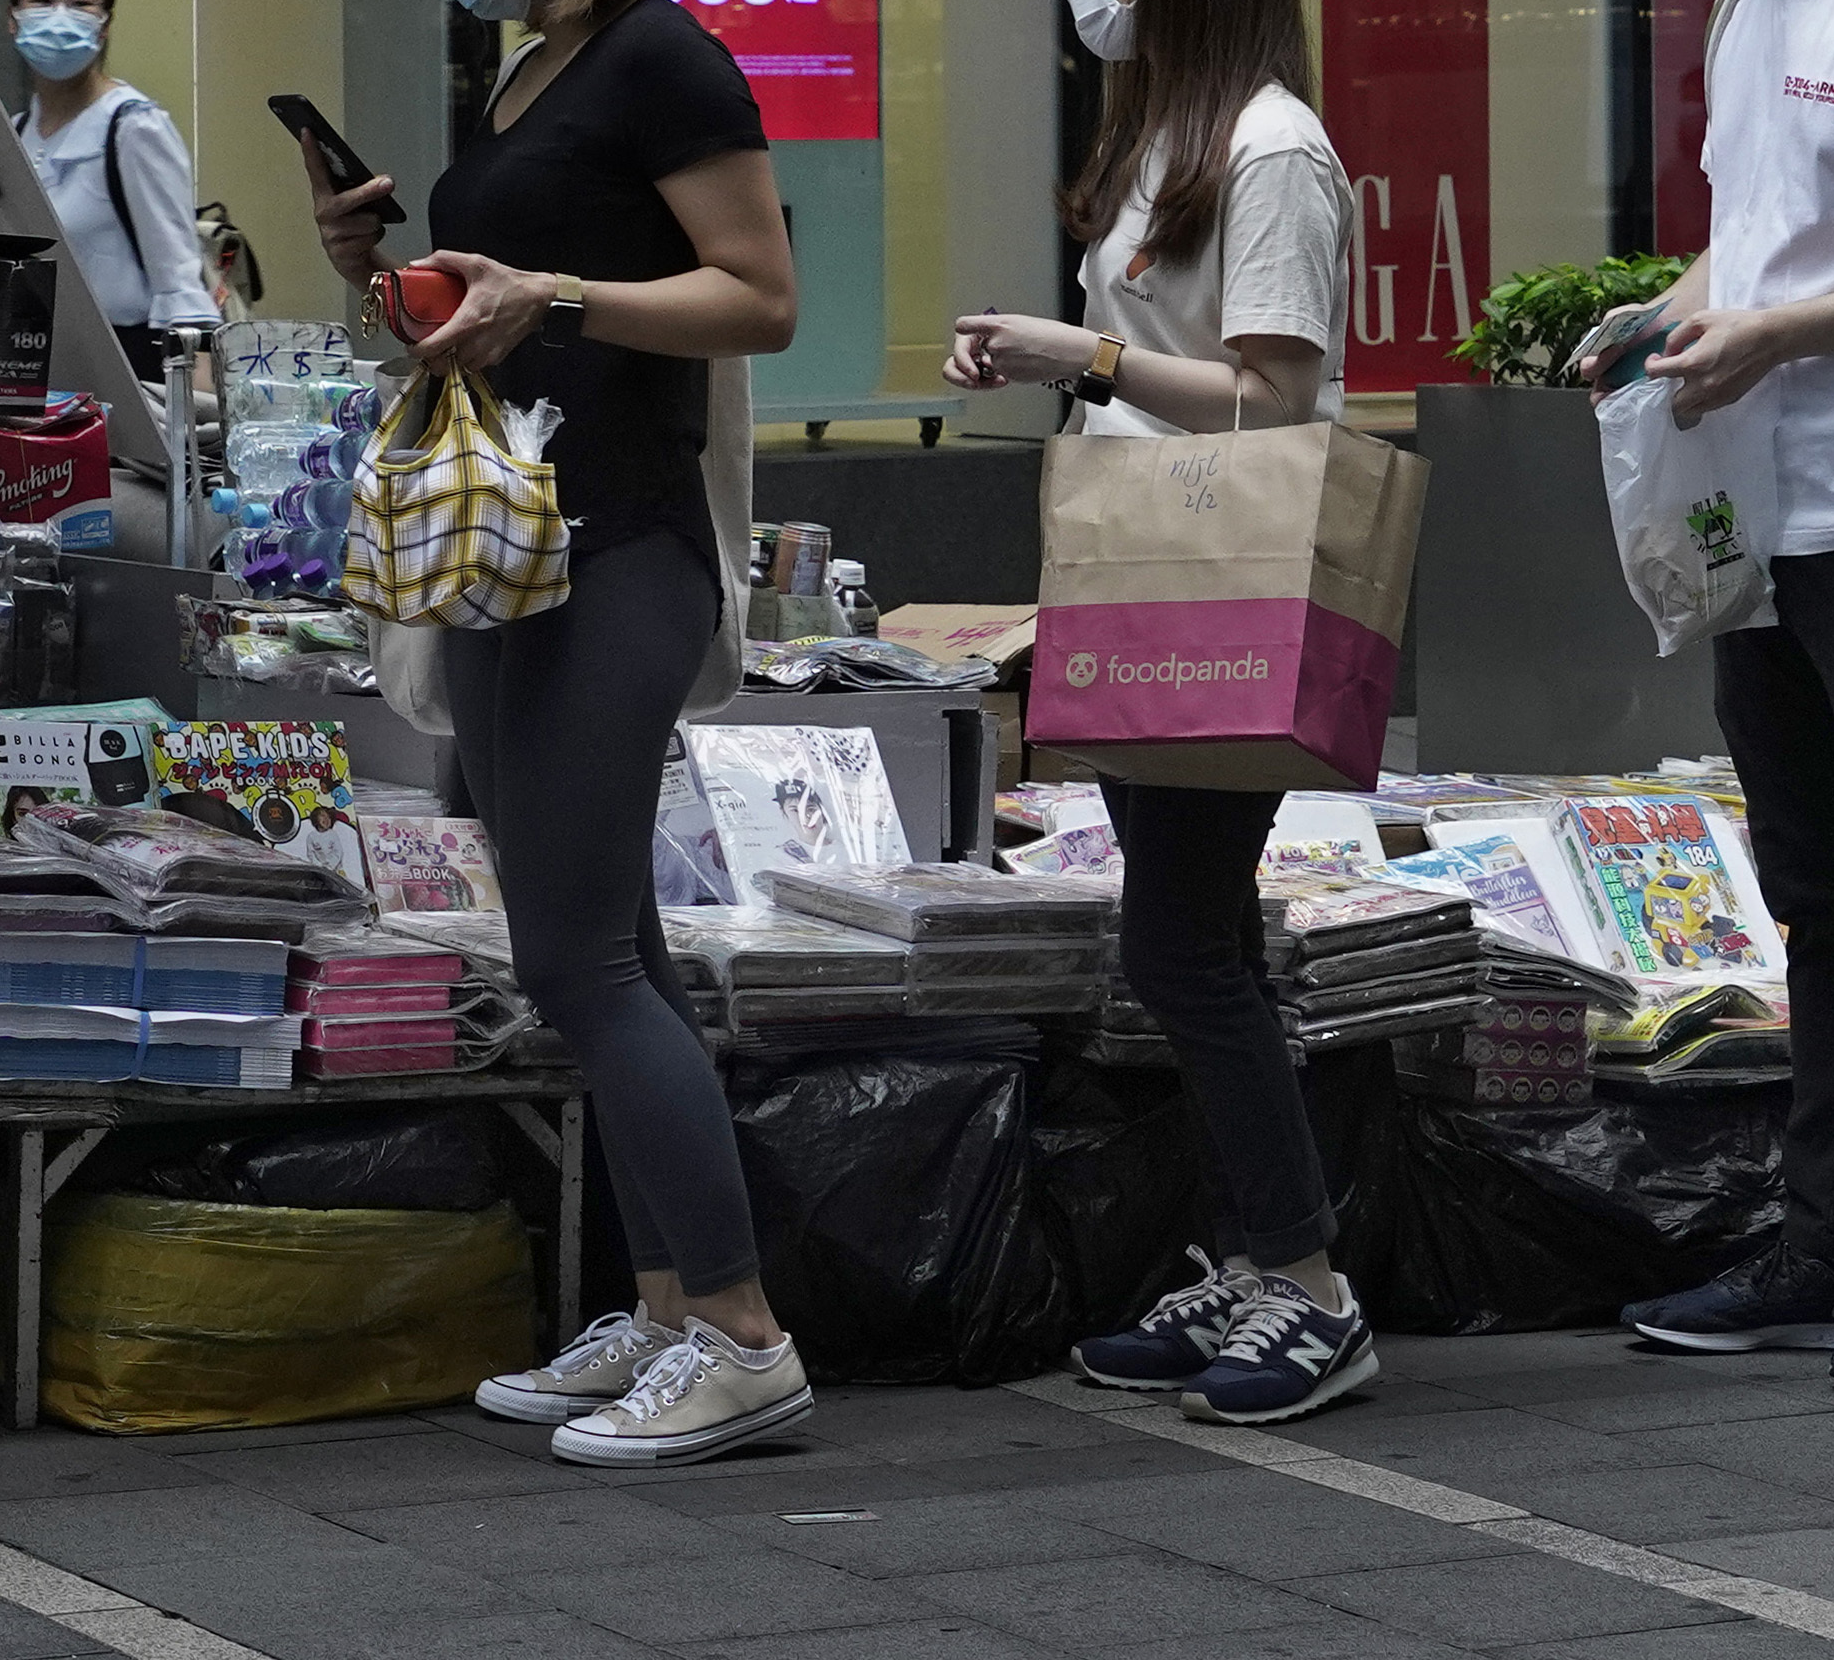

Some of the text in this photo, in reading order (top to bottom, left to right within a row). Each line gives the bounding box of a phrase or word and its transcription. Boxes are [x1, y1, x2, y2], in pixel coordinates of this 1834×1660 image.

[10, 331, 47, 350] 180
[1184, 487, 1218, 514] 2/2
[1107, 652, 1268, 690] foodpanda
[13, 734, 76, 748] BILLA
[165, 731, 330, 760] BAPE KIDS
[19, 753, 76, 766] BONG
[236, 776, 277, 786] BOOK
[715, 800, 747, 814] X-girl
[1683, 844, 1720, 867] 184
